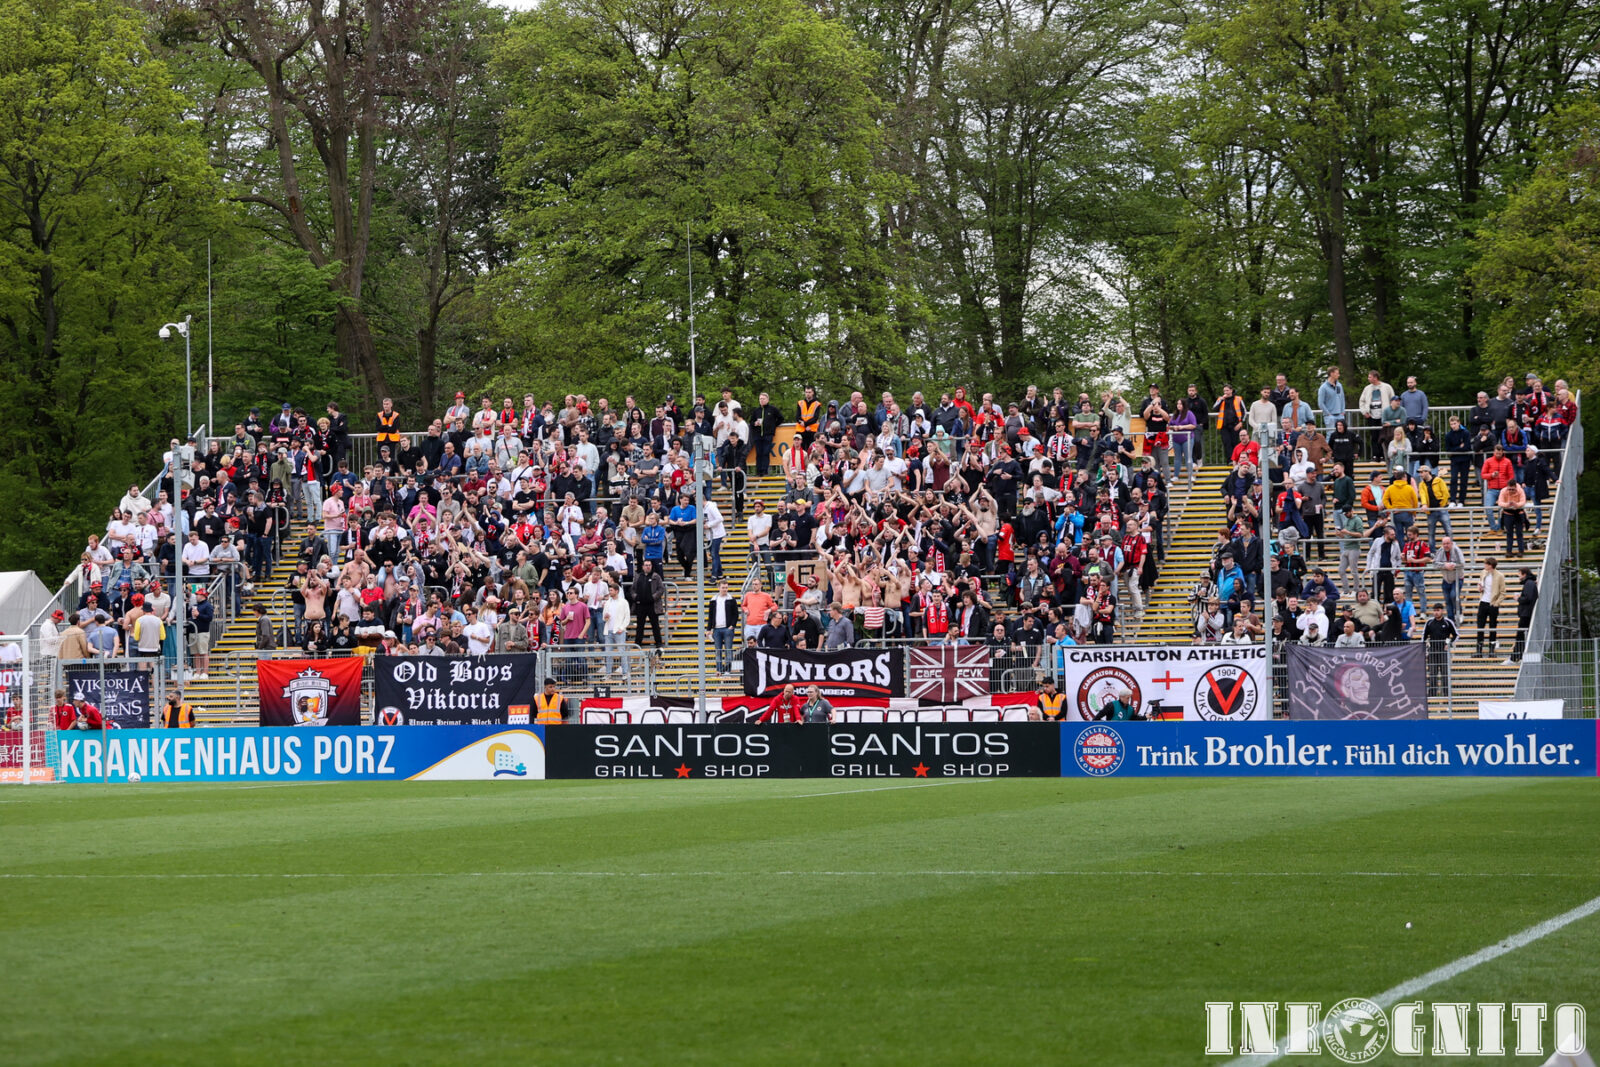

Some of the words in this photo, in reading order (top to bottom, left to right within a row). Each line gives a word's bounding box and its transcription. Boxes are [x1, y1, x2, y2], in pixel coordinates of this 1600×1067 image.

[1070, 650, 1181, 662] CARSHALTON
[1187, 648, 1266, 661] ATHLETIC
[393, 660, 437, 683] Old
[449, 660, 513, 686] Boys
[756, 651, 892, 695] JUNIORS
[957, 668, 984, 677] FCVK
[73, 678, 144, 693] VIKTORIA
[793, 687, 855, 696] HÖNBERG
[405, 687, 500, 710] Viktoria
[1240, 690, 1254, 717] KÖLN
[595, 727, 770, 757] SANTOS
[831, 726, 1010, 756] SANTOS
[1078, 728, 1108, 745] QUELLEN
[1110, 732, 1121, 745] DES
[61, 736, 302, 777] KRANKENHAUS
[314, 735, 396, 774] PORZ
[1137, 744, 1199, 766] Trink
[1204, 734, 1338, 766] Brohler.
[1345, 744, 1396, 765] Fühl
[1402, 744, 1449, 765] dich
[1456, 734, 1580, 765] wohler.
[595, 765, 664, 777] GRILL
[705, 764, 770, 777] SHOP
[831, 764, 901, 776] GRILL
[943, 763, 1010, 776] SHOP
[1079, 756, 1121, 774] WOHLSEINS
